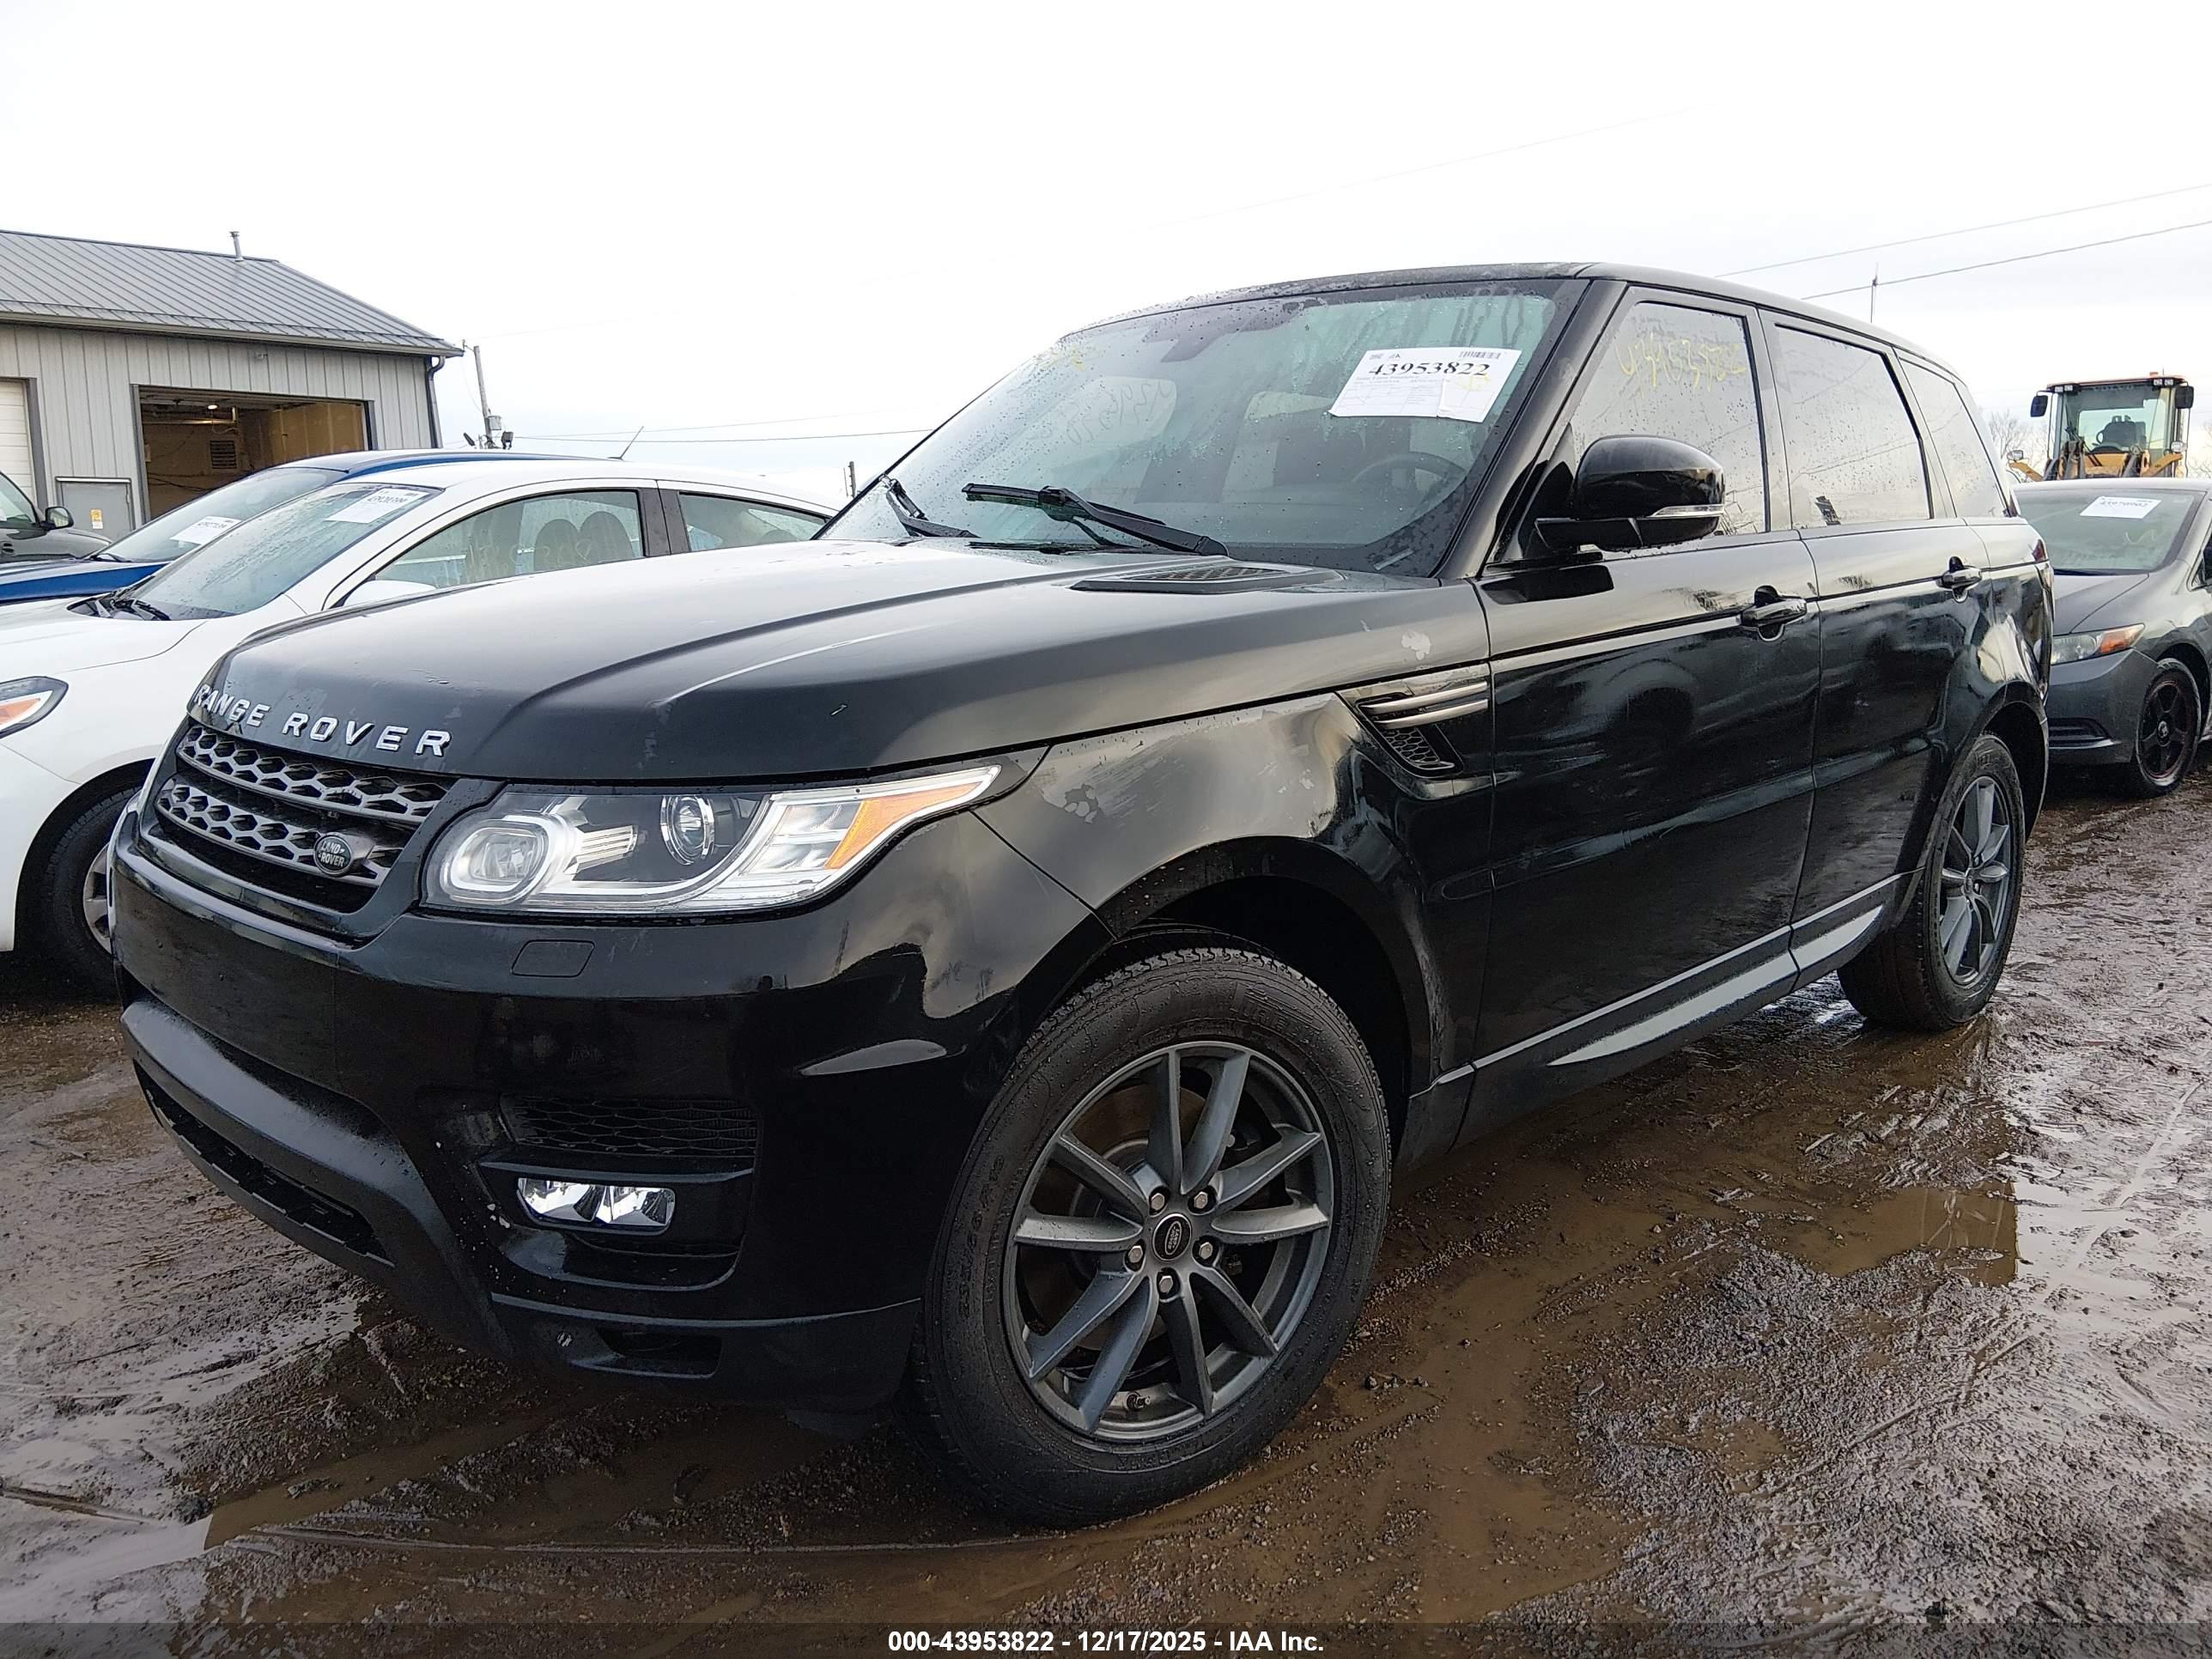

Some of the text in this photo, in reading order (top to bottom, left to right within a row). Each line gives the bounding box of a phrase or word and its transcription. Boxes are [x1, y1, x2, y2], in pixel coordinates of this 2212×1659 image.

[1369, 362, 1491, 376] 43953822
[194, 684, 451, 757] RANGE ROVER
[320, 852, 345, 867] ROVER
